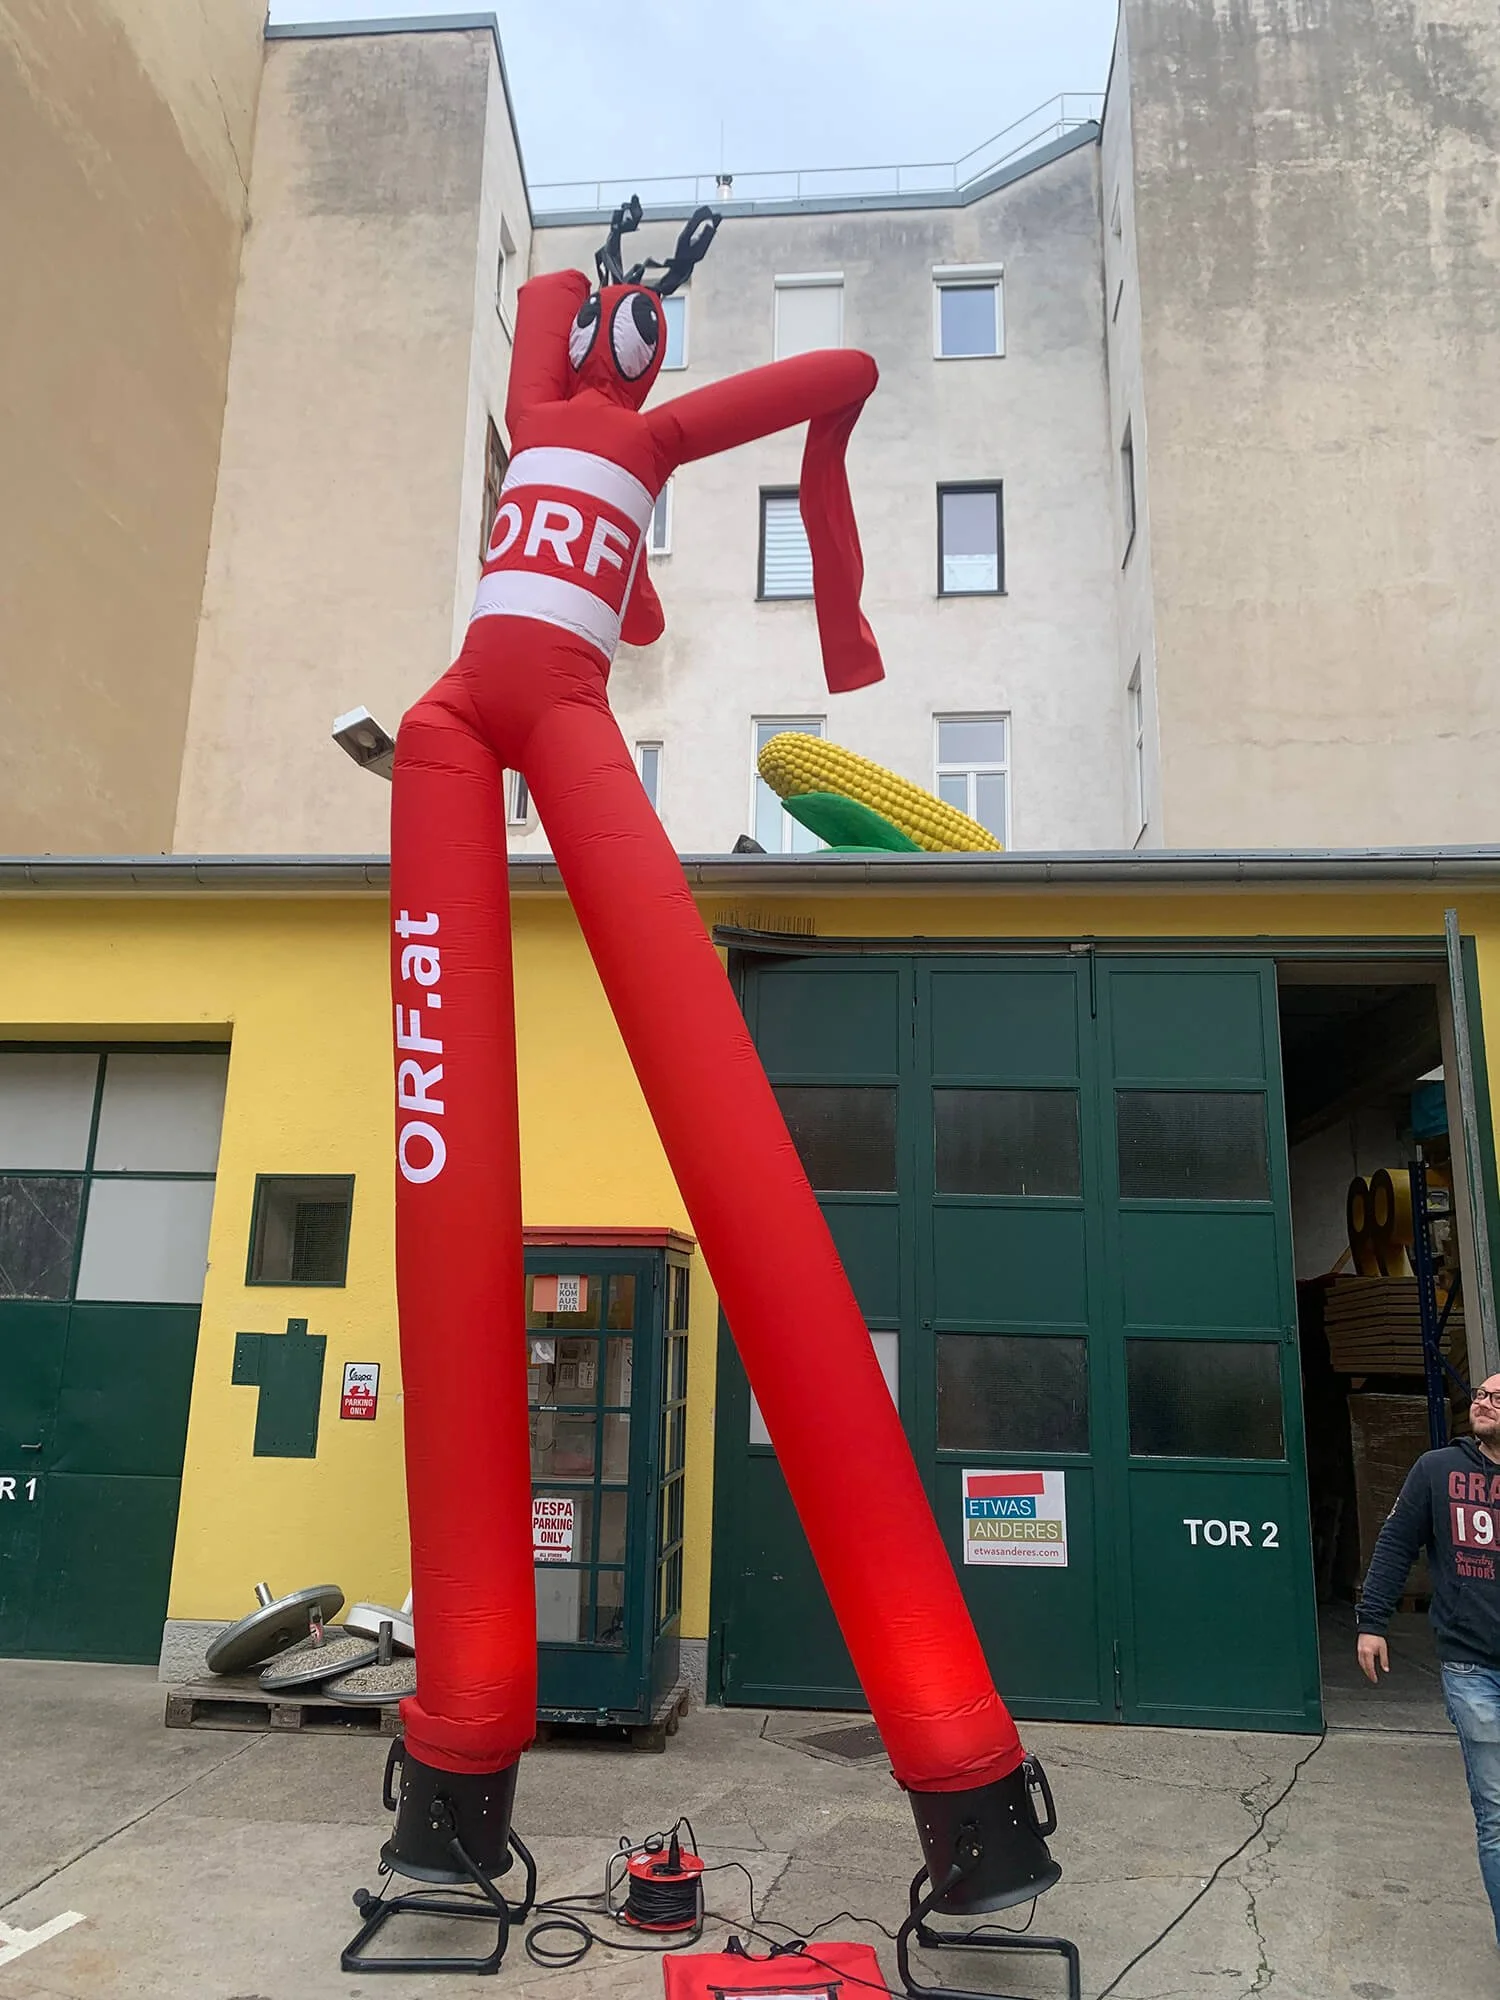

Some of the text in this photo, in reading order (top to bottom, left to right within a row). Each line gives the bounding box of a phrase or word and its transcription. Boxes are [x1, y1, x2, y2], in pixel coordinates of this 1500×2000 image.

[486, 499, 631, 577] ORF
[395, 910, 447, 1184] ORF.at
[559, 1282, 578, 1290] TELE
[559, 1297, 578, 1305] AUS
[348, 1367, 373, 1382] Vespa
[344, 1398, 374, 1407] PARKING
[350, 1406, 367, 1416] ONLY
[25, 1477, 37, 1501] 1
[534, 1501, 573, 1516] VESPA
[969, 1499, 1032, 1516] ETWAS
[533, 1517, 573, 1531] PARKING
[974, 1521, 1058, 1540] ANDERES
[1456, 1507, 1494, 1545] 19
[540, 1531, 564, 1545] ONLY
[1183, 1519, 1280, 1548] TOR 2
[974, 1546, 1059, 1558] etwasanderes.com
[1456, 1563, 1496, 1580] MOTORS
